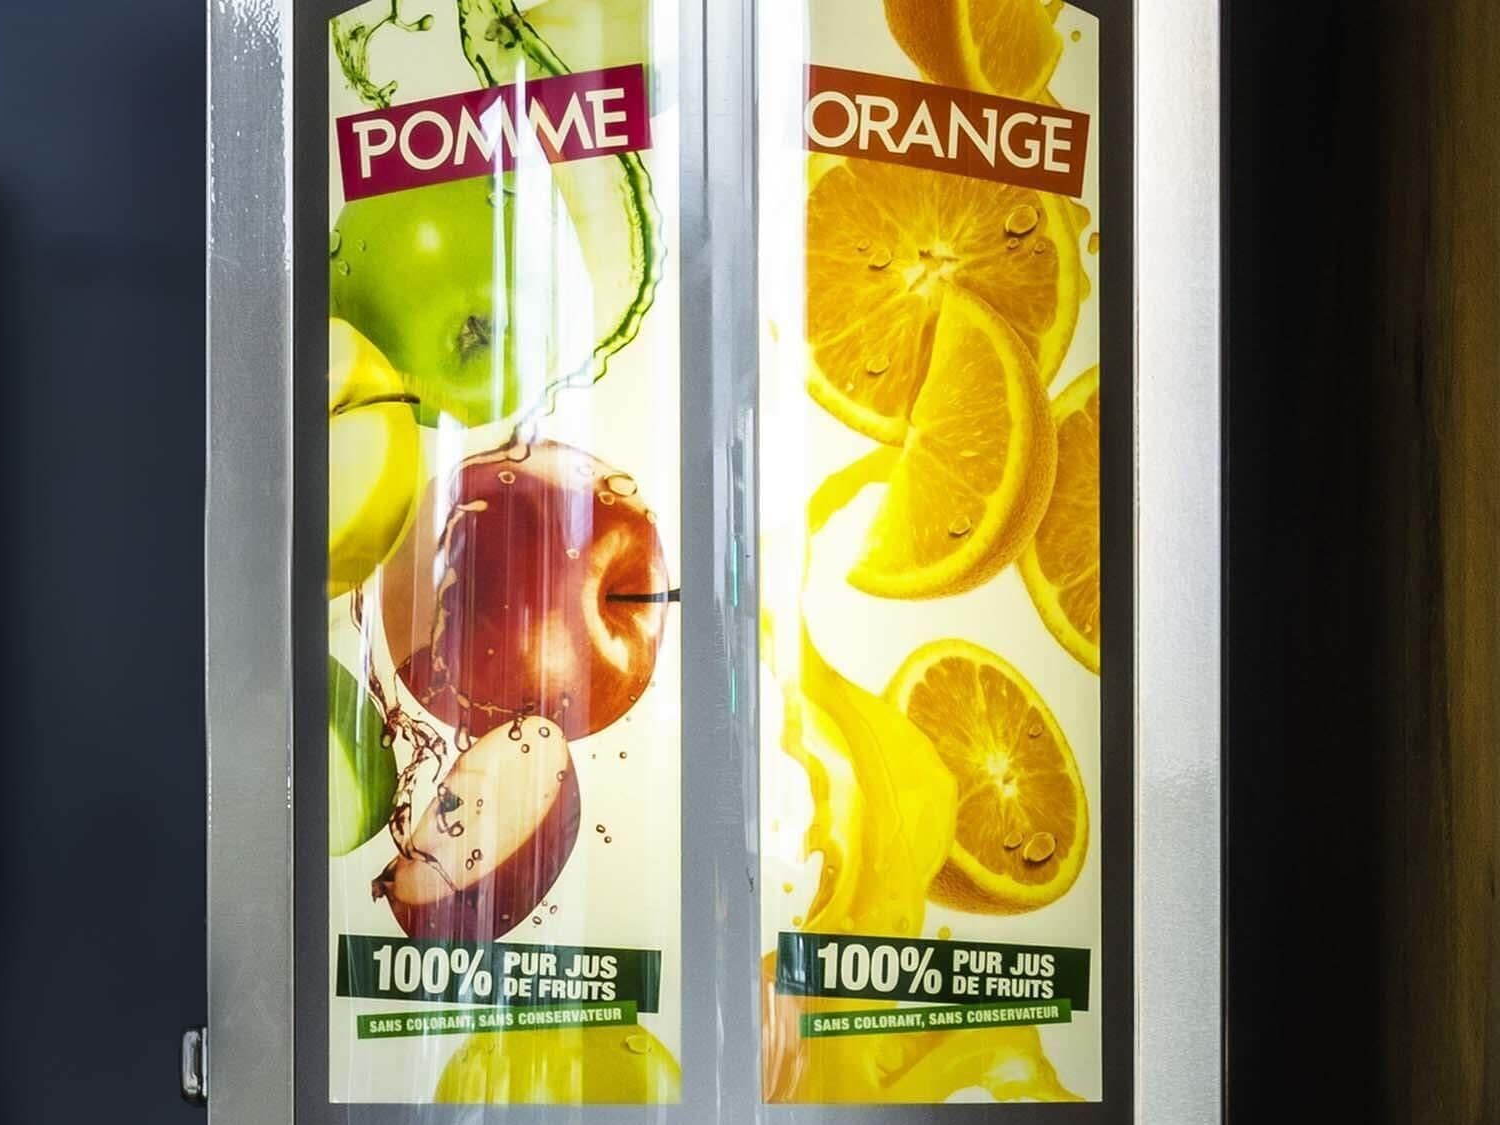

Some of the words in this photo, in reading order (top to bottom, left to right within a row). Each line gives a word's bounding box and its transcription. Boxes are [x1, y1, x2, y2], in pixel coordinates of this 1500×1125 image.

[352, 87, 629, 180] POMME
[803, 90, 1074, 174] ORANGE
[373, 944, 493, 997] 100%
[504, 951, 557, 977] PUR
[564, 955, 619, 979] JUS
[817, 942, 943, 995] 100%
[952, 949, 1002, 975] PUR
[1009, 953, 1055, 978] JUS
[952, 975, 980, 996] DE
[986, 976, 1055, 999] FRUITS
[504, 977, 532, 998] DE
[538, 978, 617, 1001] FRUITS
[369, 1019, 402, 1033] SANS
[478, 1012, 514, 1028] SANS
[518, 1007, 622, 1025] CONSERVATEUR
[813, 1018, 850, 1032] SANS
[928, 1011, 963, 1026] SANS
[967, 1005, 1059, 1023] CONSERVATEUR
